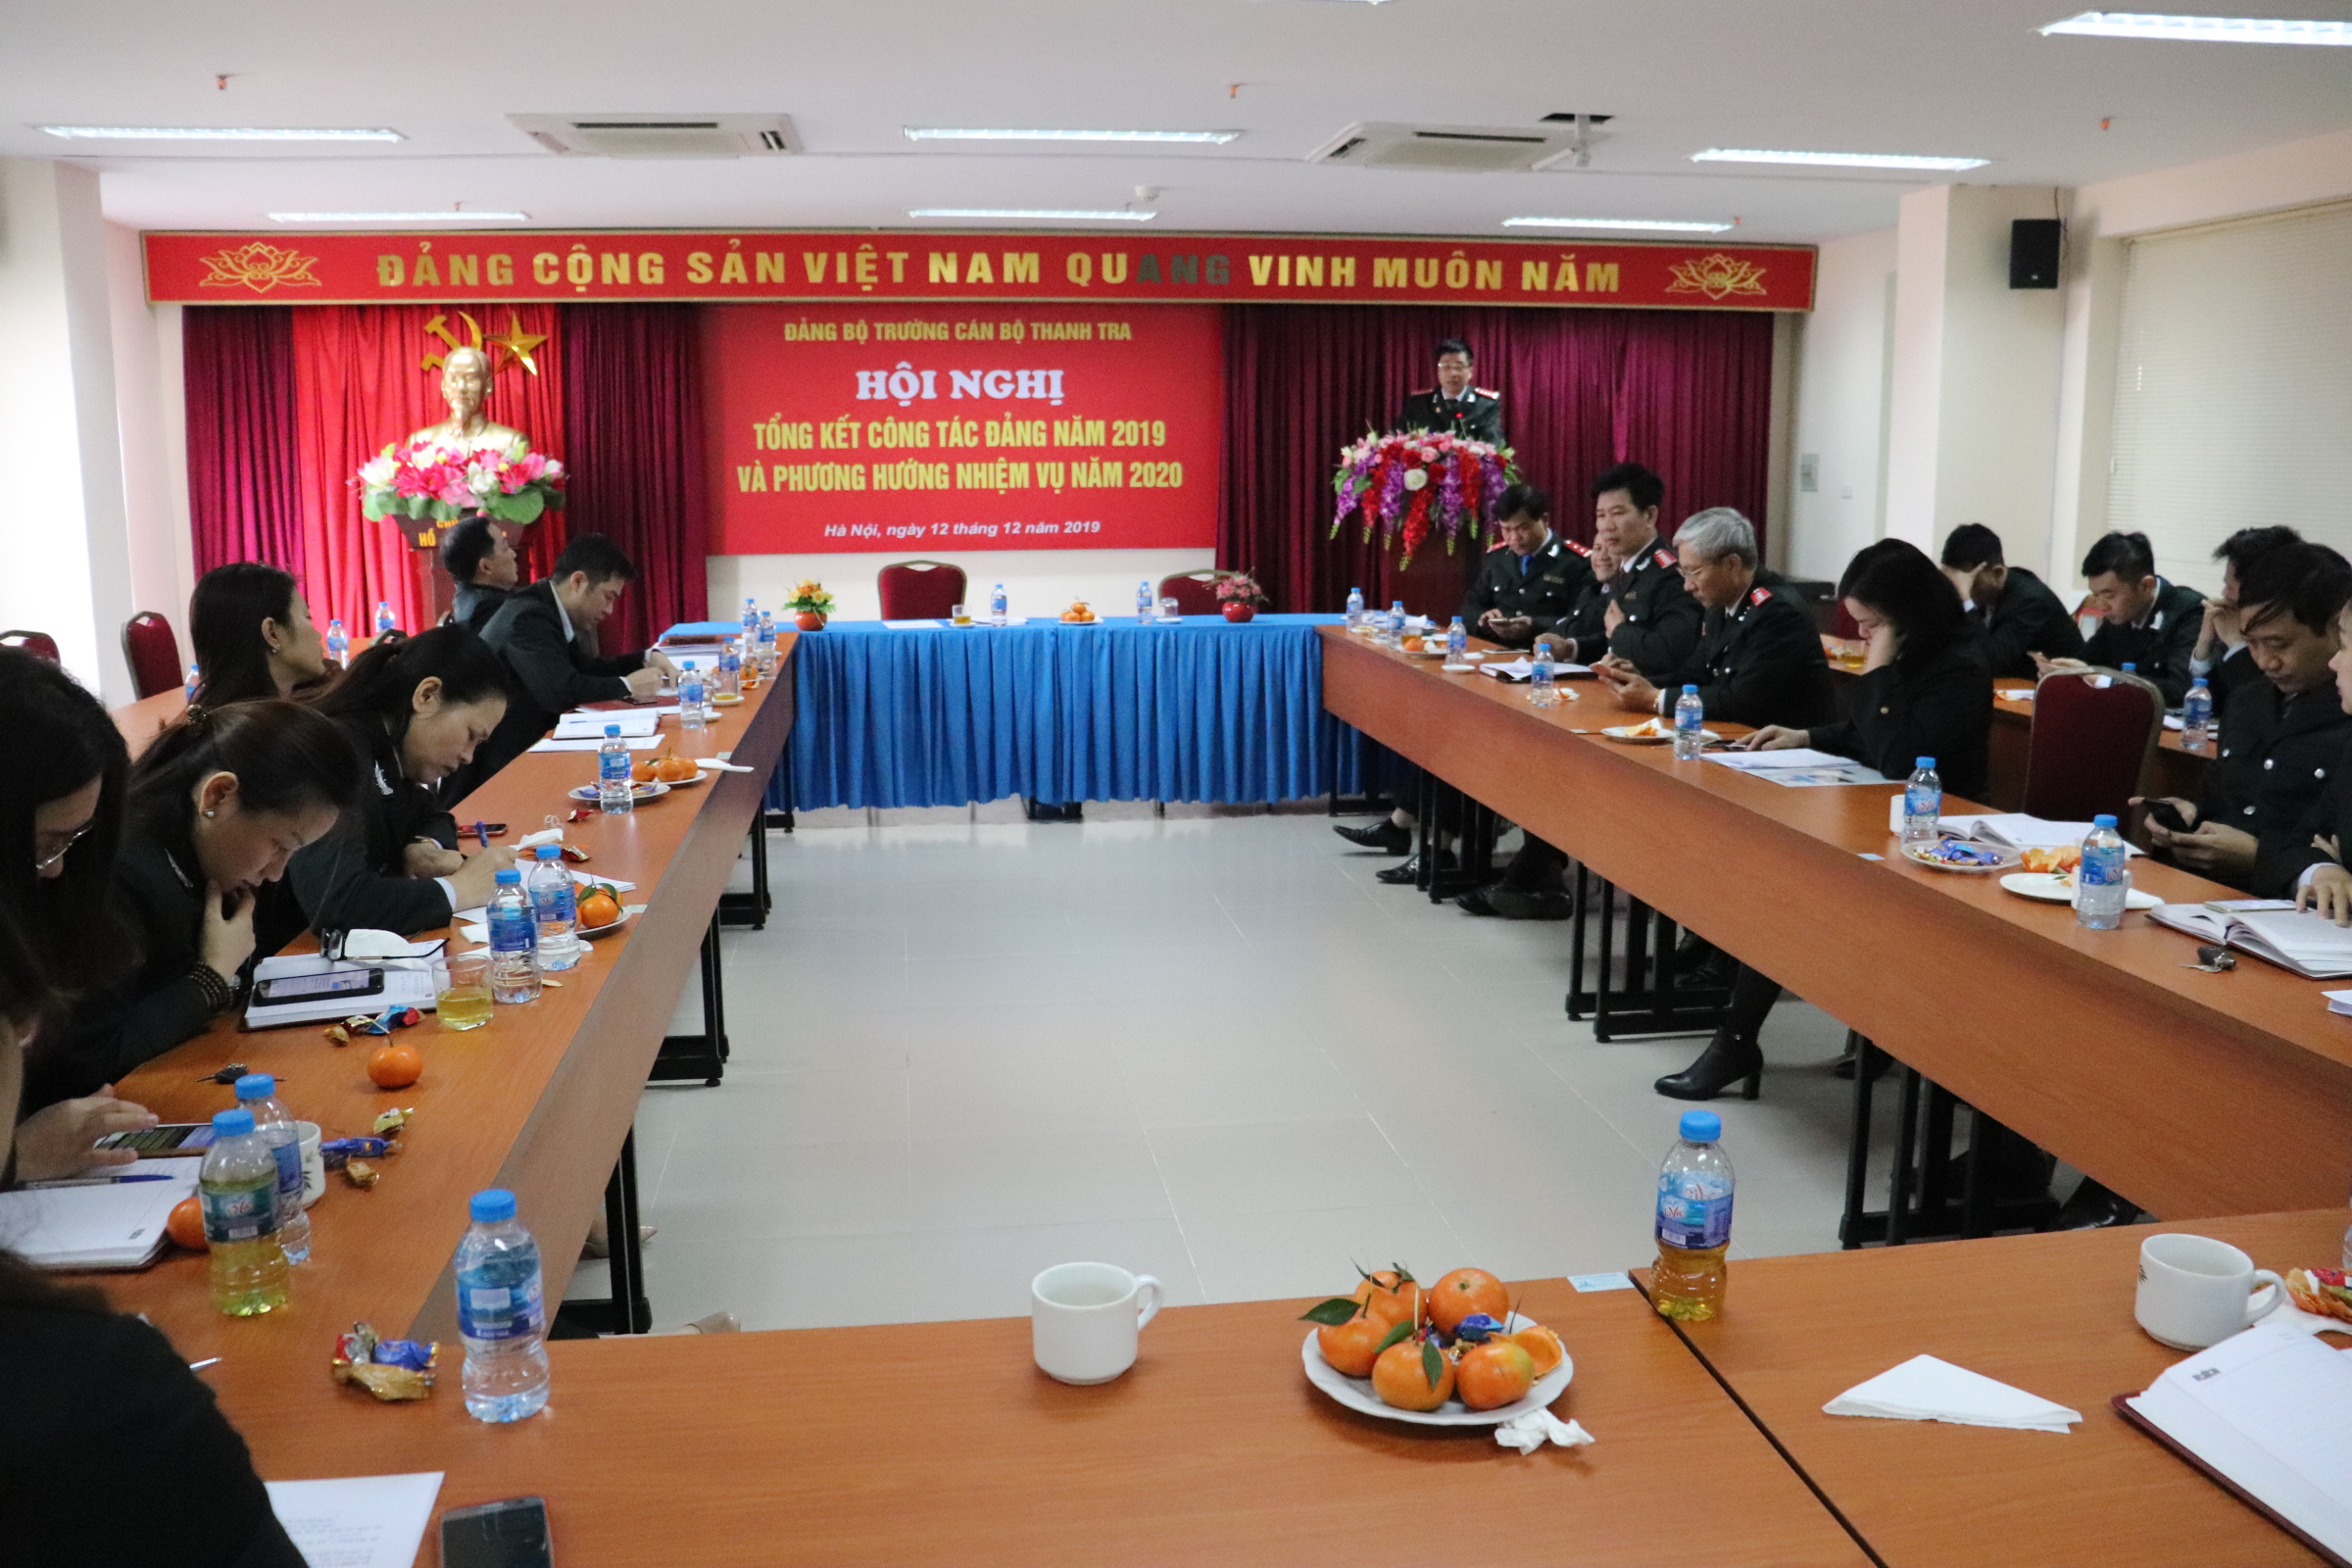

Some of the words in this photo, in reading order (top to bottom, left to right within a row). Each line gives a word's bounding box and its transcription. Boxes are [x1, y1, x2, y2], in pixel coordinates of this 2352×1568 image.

[376, 241, 514, 286] ĐẢNG
[532, 243, 664, 292] CỘNG
[687, 238, 784, 284] SẢN
[804, 243, 908, 291] VIỆT
[928, 252, 1040, 283] NAM
[1066, 252, 1231, 287] QUANG
[1248, 255, 1355, 287] VINH
[1373, 250, 1502, 290] MUÔN
[1522, 253, 1619, 293] NĂM
[784, 317, 837, 341] ĐẢNG
[843, 319, 868, 345] BỘ
[874, 318, 949, 340] TRƯỜNG
[955, 318, 994, 340] CÁN
[999, 318, 1025, 344] BỘ
[1030, 321, 1092, 340] THANH
[1098, 321, 1132, 340] TRA
[856, 361, 938, 407] HỘI
[949, 369, 1064, 406] NGHỊ
[753, 412, 813, 450] TỔNG
[820, 414, 861, 449] KẾT
[867, 416, 930, 448] CÔNG
[936, 416, 978, 448] TÁC
[985, 412, 1047, 447] ĐẢNG
[1054, 415, 1105, 447] NĂM
[1111, 419, 1165, 447] 2019
[737, 460, 767, 493] VÀ
[773, 462, 865, 492] PHƯƠNG
[872, 458, 950, 490] HƯỚNG
[956, 457, 1029, 495] NHIỆM
[1035, 463, 1064, 494] VỤ
[1071, 456, 1123, 488] NĂM
[1129, 462, 1183, 488] 2020
[824, 524, 847, 537] Hà
[851, 523, 881, 539] Nội,
[886, 523, 926, 538] ngày
[931, 522, 949, 535] 12
[954, 522, 998, 537] tháng
[1004, 521, 1021, 534] 12
[1025, 521, 1058, 534] năm
[1063, 520, 1101, 534] 2019
